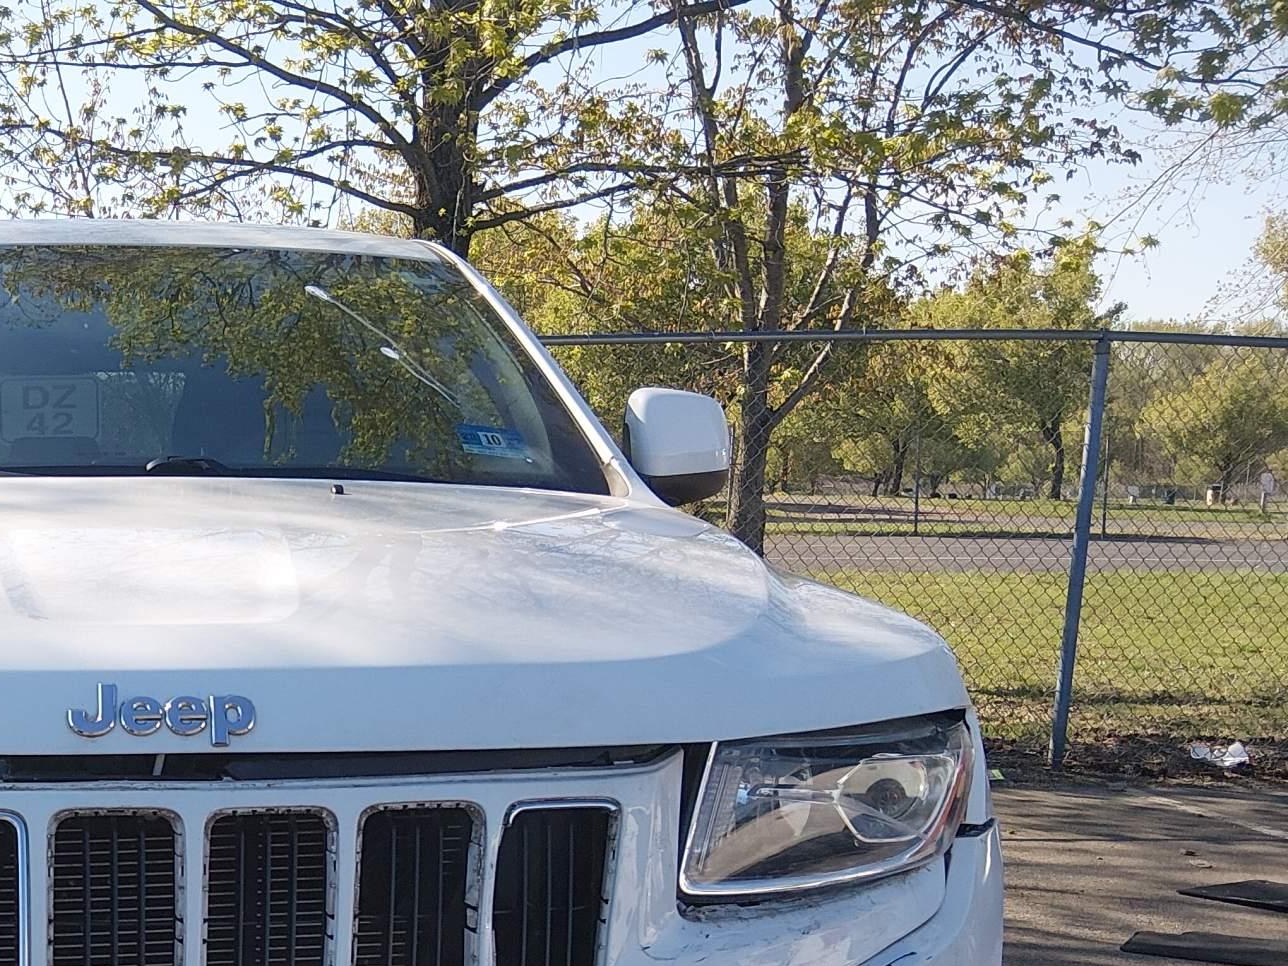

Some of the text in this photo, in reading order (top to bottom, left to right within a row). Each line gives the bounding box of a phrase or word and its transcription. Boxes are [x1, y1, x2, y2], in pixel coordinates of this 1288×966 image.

[22, 384, 76, 410] DZ
[26, 411, 74, 435] 42
[482, 433, 502, 446] 10
[66, 682, 257, 748] Jeep
